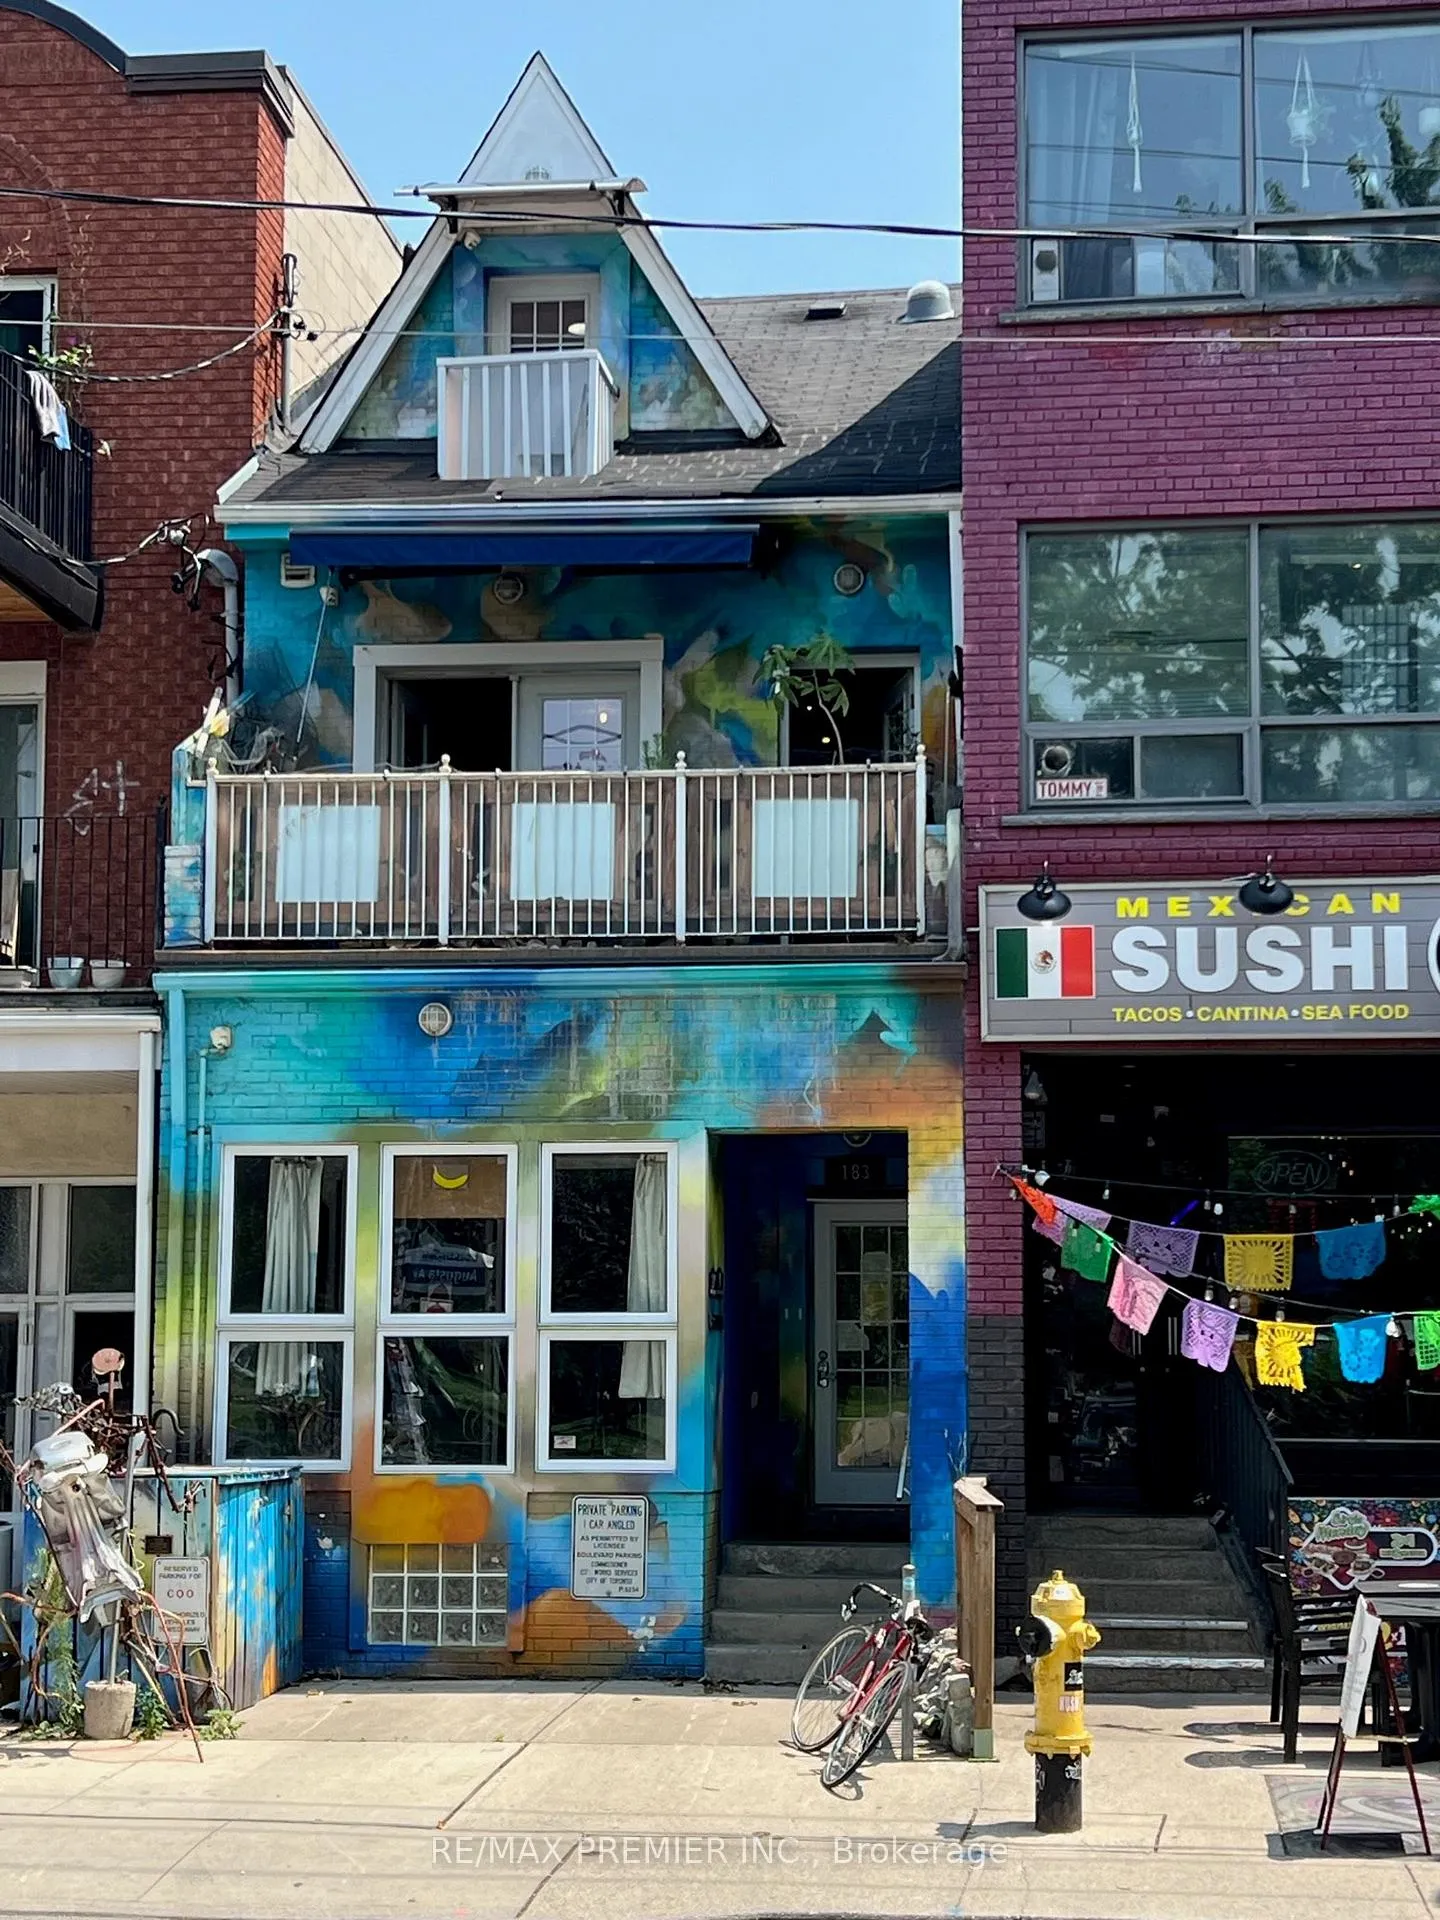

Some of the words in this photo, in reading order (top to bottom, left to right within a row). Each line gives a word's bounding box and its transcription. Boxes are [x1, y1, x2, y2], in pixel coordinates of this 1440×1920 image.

[1039, 781, 1091, 797] TOMMY
[1115, 891, 1401, 919] MEXCAN
[1111, 924, 1409, 993] SUSHI
[1112, 1006, 1182, 1023] TACOS
[1197, 1005, 1289, 1022] CANTINA
[1301, 1004, 1343, 1021] SEA
[1348, 1003, 1410, 1021] FOOD
[841, 1164, 870, 1180] 183
[1257, 1162, 1322, 1186] OPEN
[578, 1504, 607, 1516] PRIVATE
[611, 1504, 643, 1517] PARKING
[589, 1519, 604, 1530] CAR
[608, 1520, 635, 1530] ANGLED
